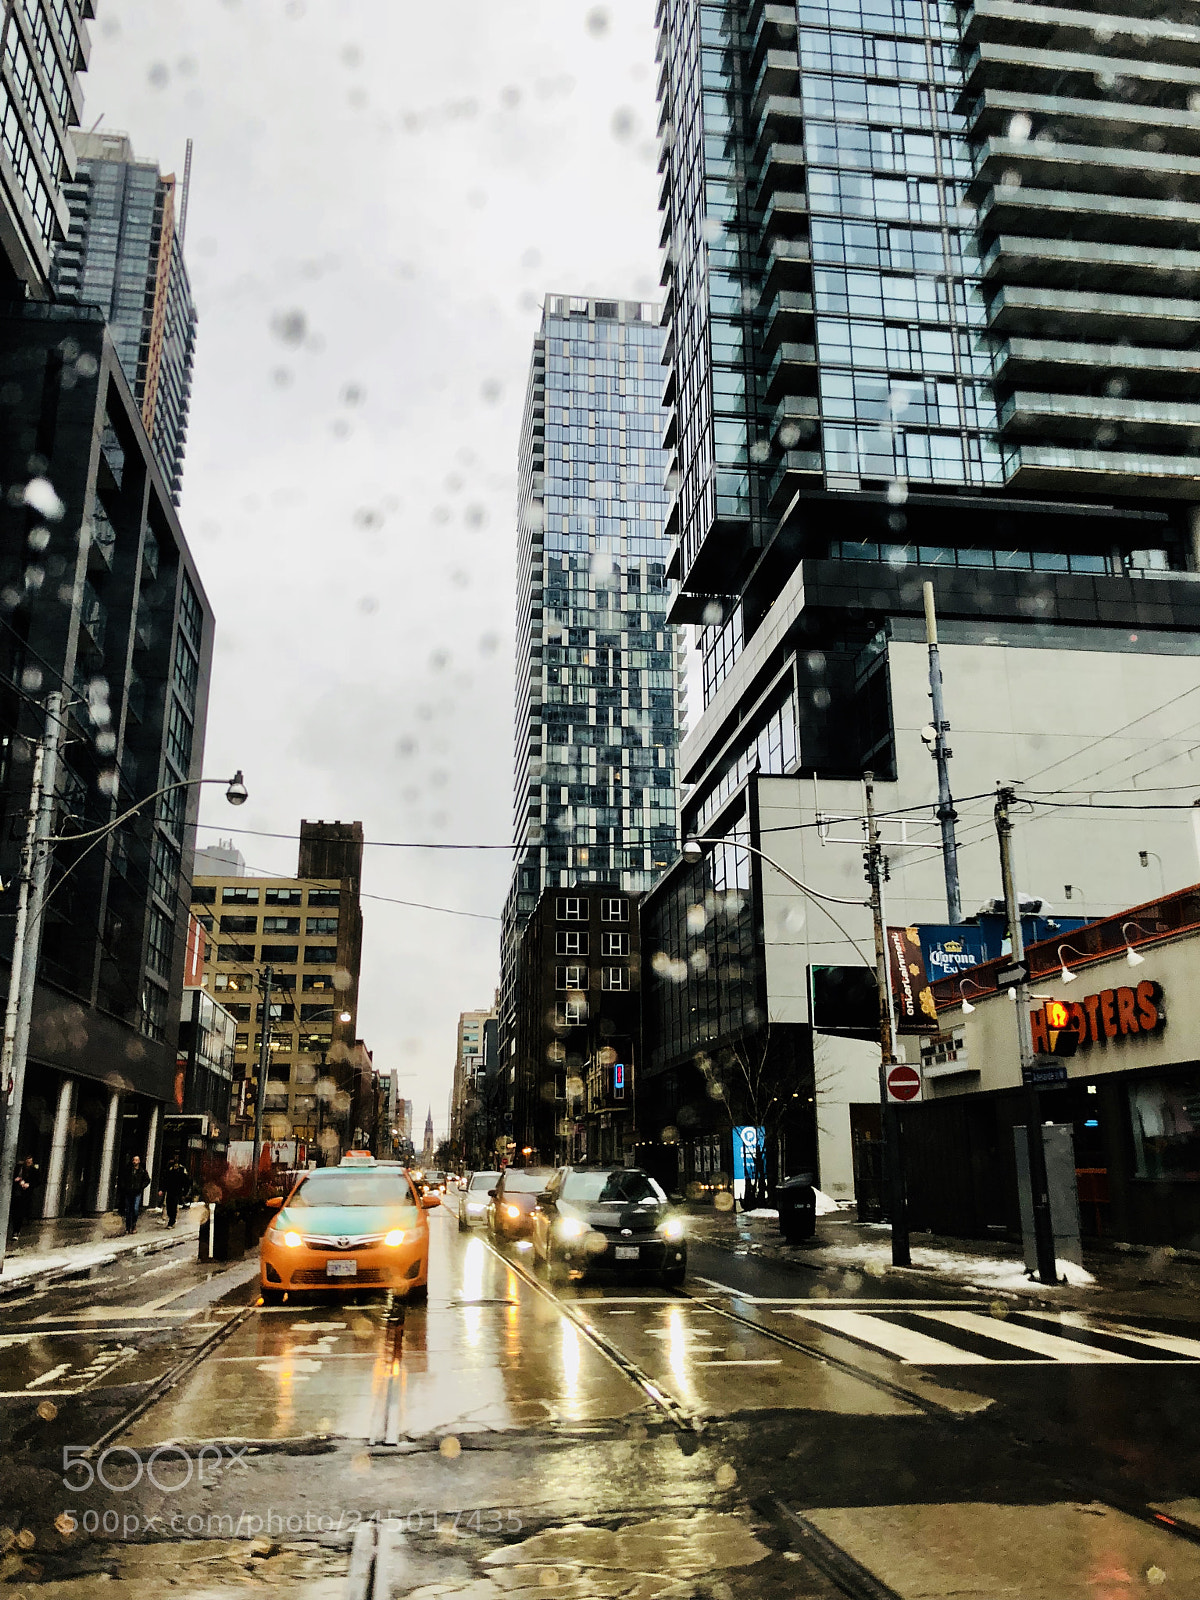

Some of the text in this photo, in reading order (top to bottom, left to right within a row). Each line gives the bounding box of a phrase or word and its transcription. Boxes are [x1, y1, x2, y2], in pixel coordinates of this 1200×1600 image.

[891, 932, 915, 1016] entertainment
[929, 950, 978, 967] Corona
[1029, 979, 1158, 1054] HOTERS
